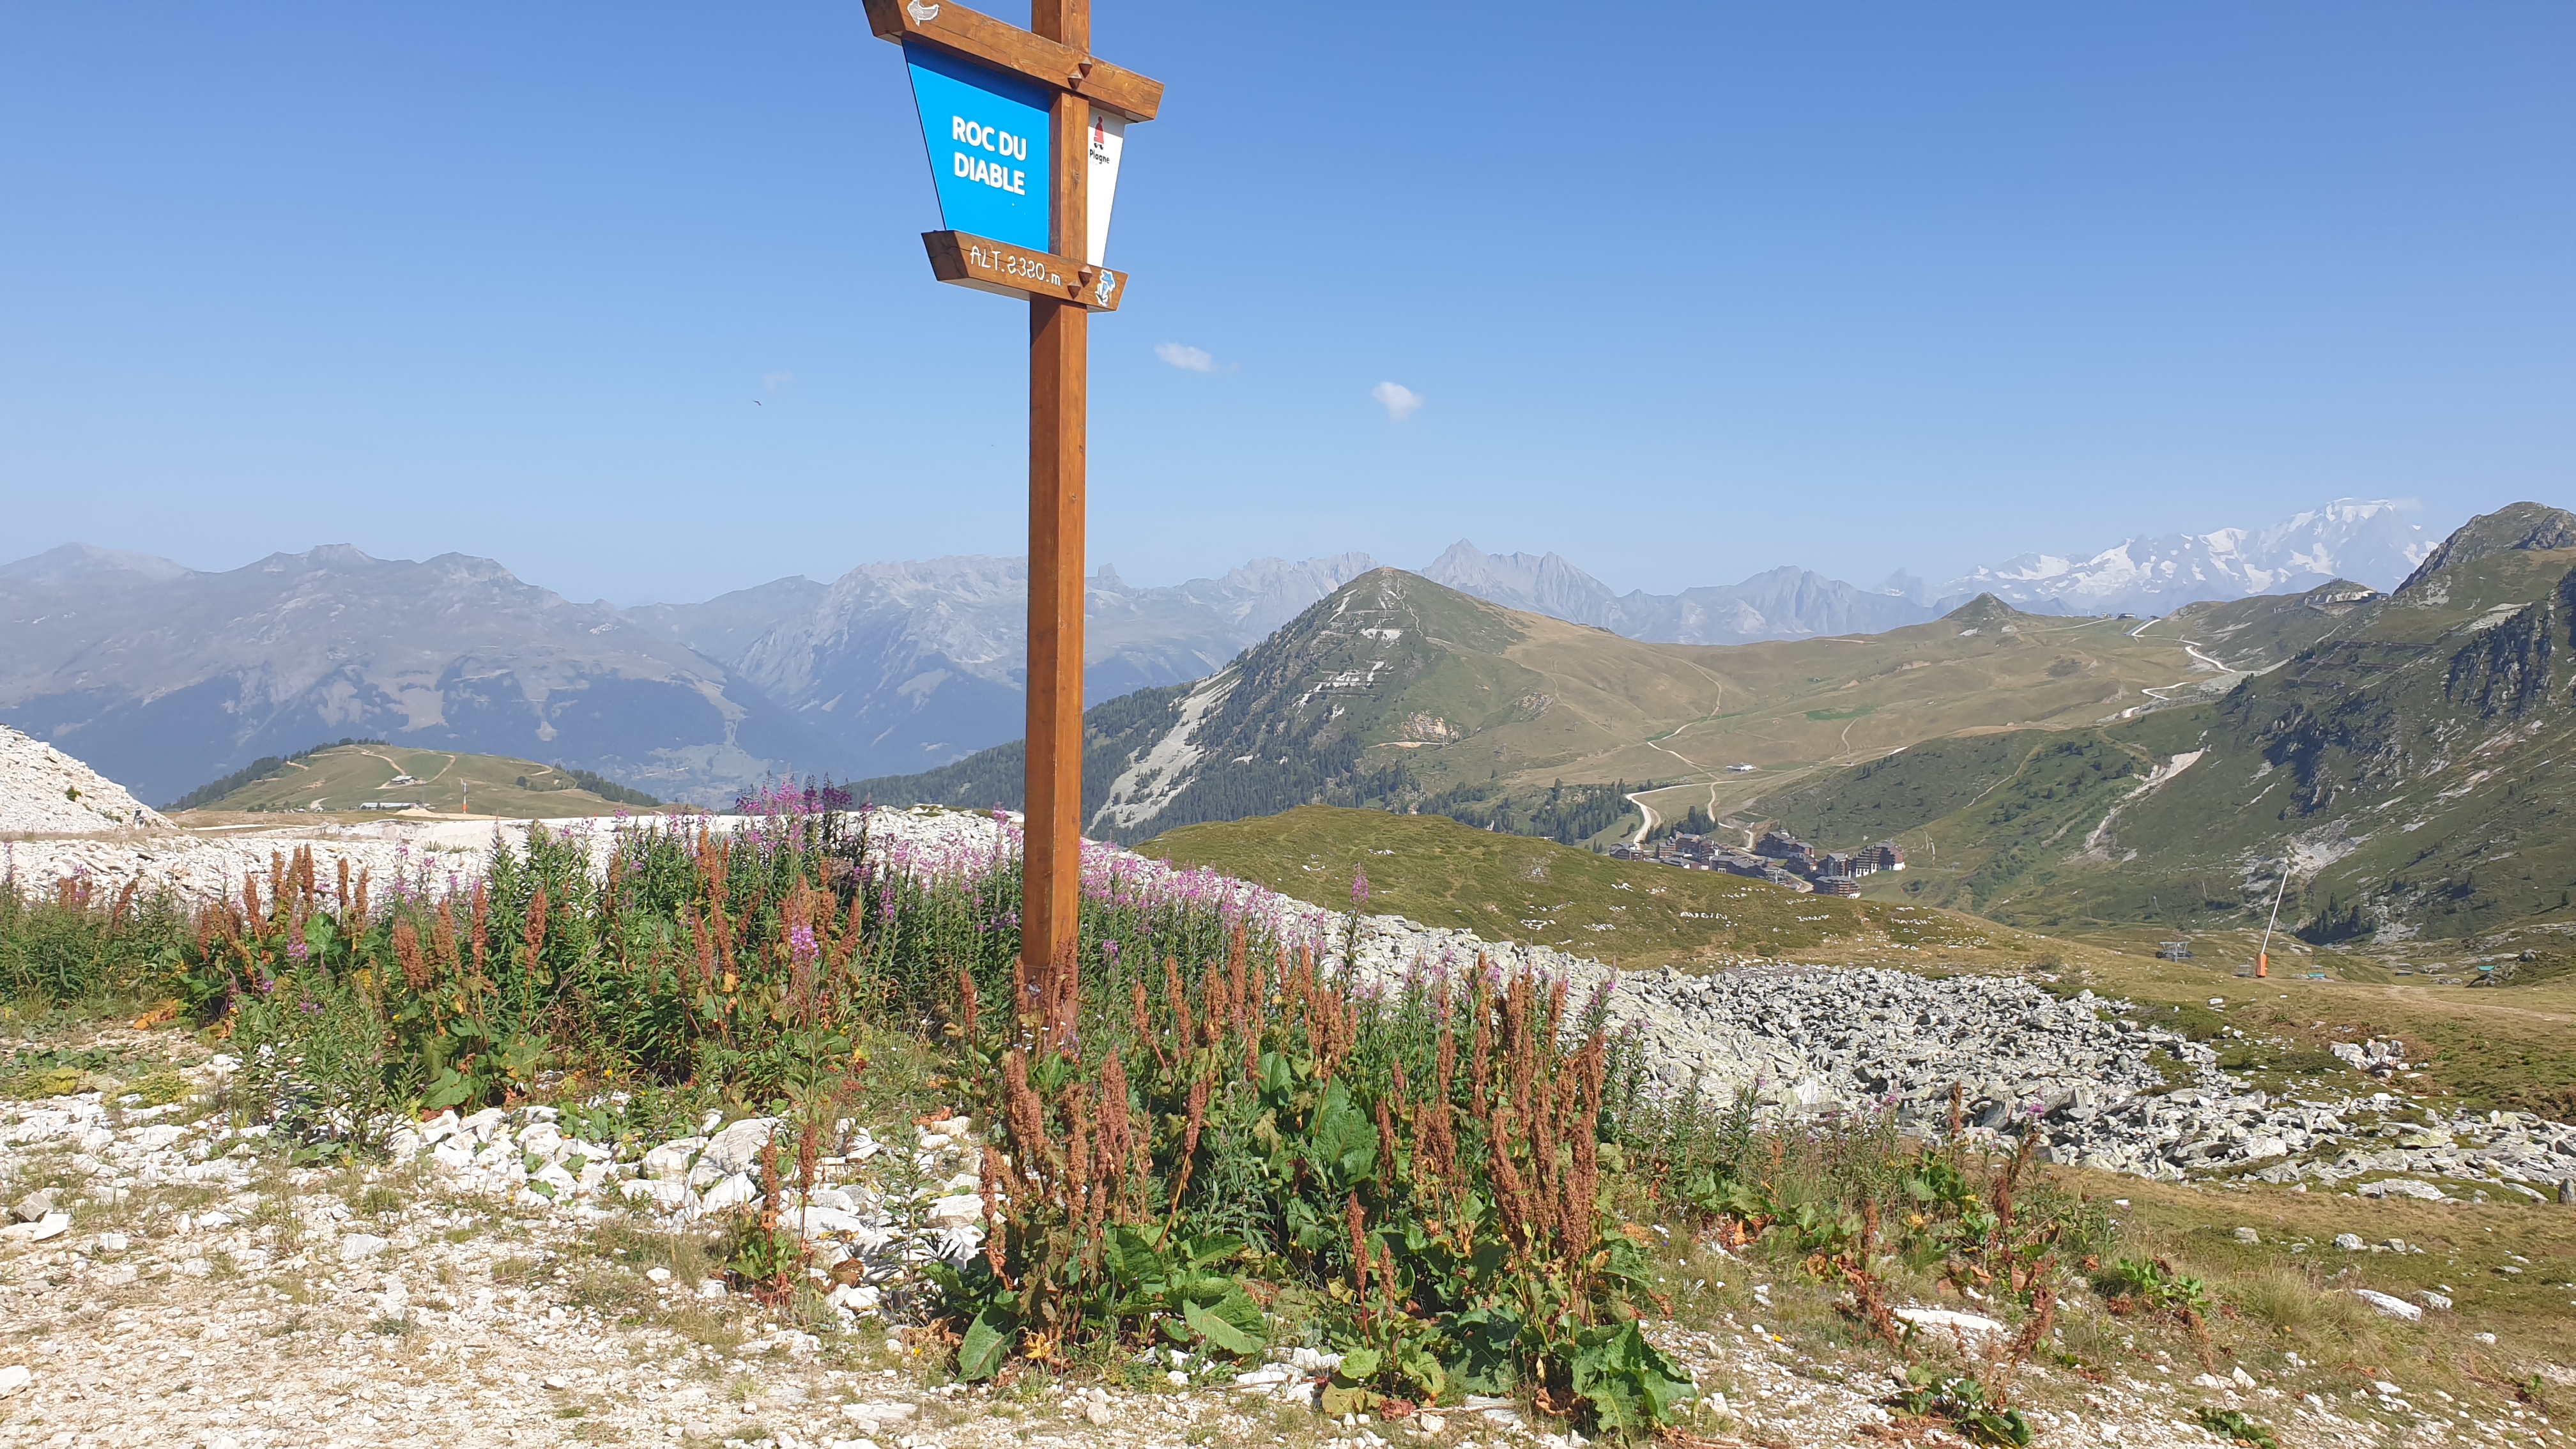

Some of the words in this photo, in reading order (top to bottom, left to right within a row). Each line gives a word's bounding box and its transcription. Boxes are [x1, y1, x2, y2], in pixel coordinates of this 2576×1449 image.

[952, 115, 995, 152] ROC
[999, 130, 1027, 161] DU
[1089, 148, 1110, 165] Plagne
[954, 151, 1025, 196] DIABLE
